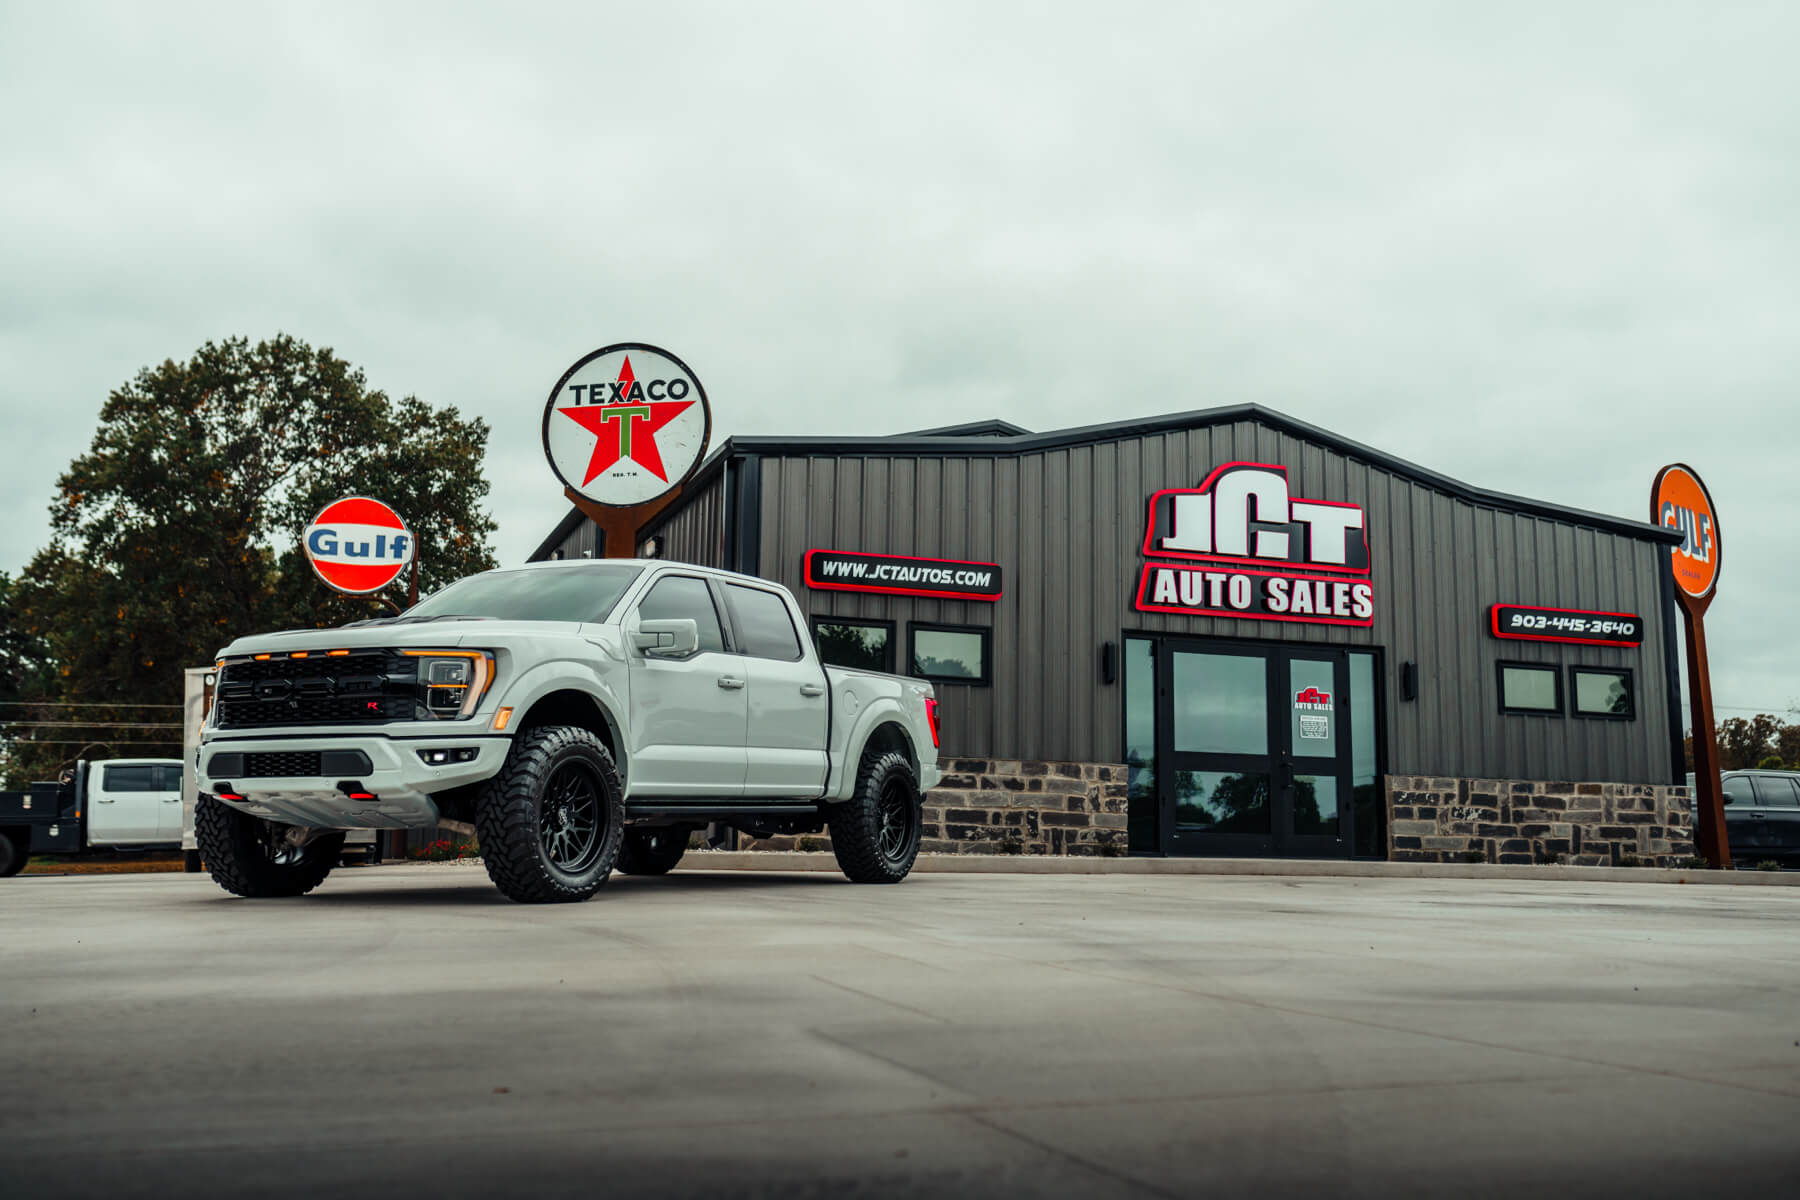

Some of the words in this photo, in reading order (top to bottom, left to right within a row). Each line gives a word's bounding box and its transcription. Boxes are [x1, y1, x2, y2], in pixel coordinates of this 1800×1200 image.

[569, 378, 689, 406] TEXACO
[600, 405, 651, 459] T
[1162, 469, 1363, 564] JCT
[308, 529, 409, 559] Gulf
[822, 560, 991, 587] WWW.JCTAUTOS.COM
[1153, 568, 1252, 610] AUTO
[1266, 577, 1374, 618] SALES
[1511, 614, 1635, 635] 903-445-3640
[1296, 687, 1331, 704] JCT
